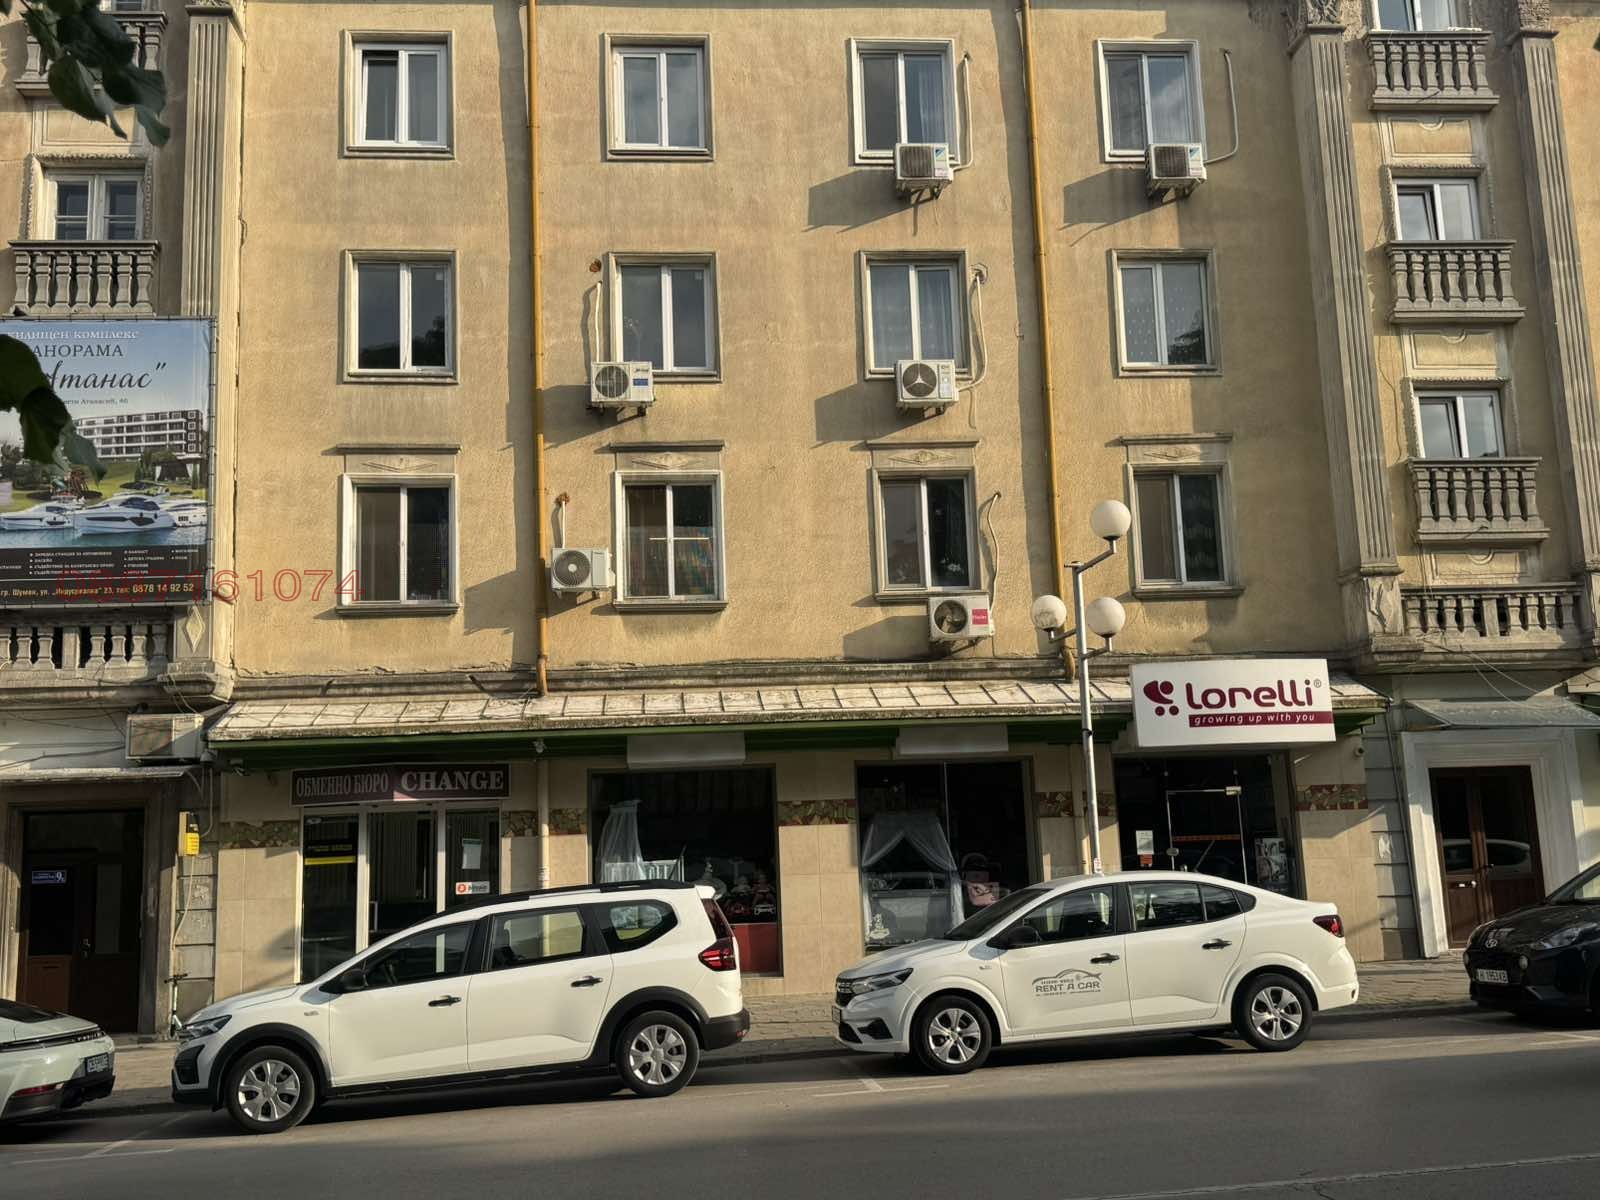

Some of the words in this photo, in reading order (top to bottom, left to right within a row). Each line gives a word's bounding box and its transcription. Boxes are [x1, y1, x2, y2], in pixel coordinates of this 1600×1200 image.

[33, 344, 123, 357] АНОРАМА
[170, 583, 181, 592] 92
[183, 583, 194, 592] 52
[1194, 714, 1243, 726] growing
[1248, 714, 1262, 724] up
[1267, 711, 1291, 722] with
[1296, 711, 1315, 723] you
[295, 775, 350, 798] ОБМЕННО
[353, 772, 389, 794] БЮРО
[401, 770, 504, 792] CHANGE
[1078, 981, 1101, 990] CAR
